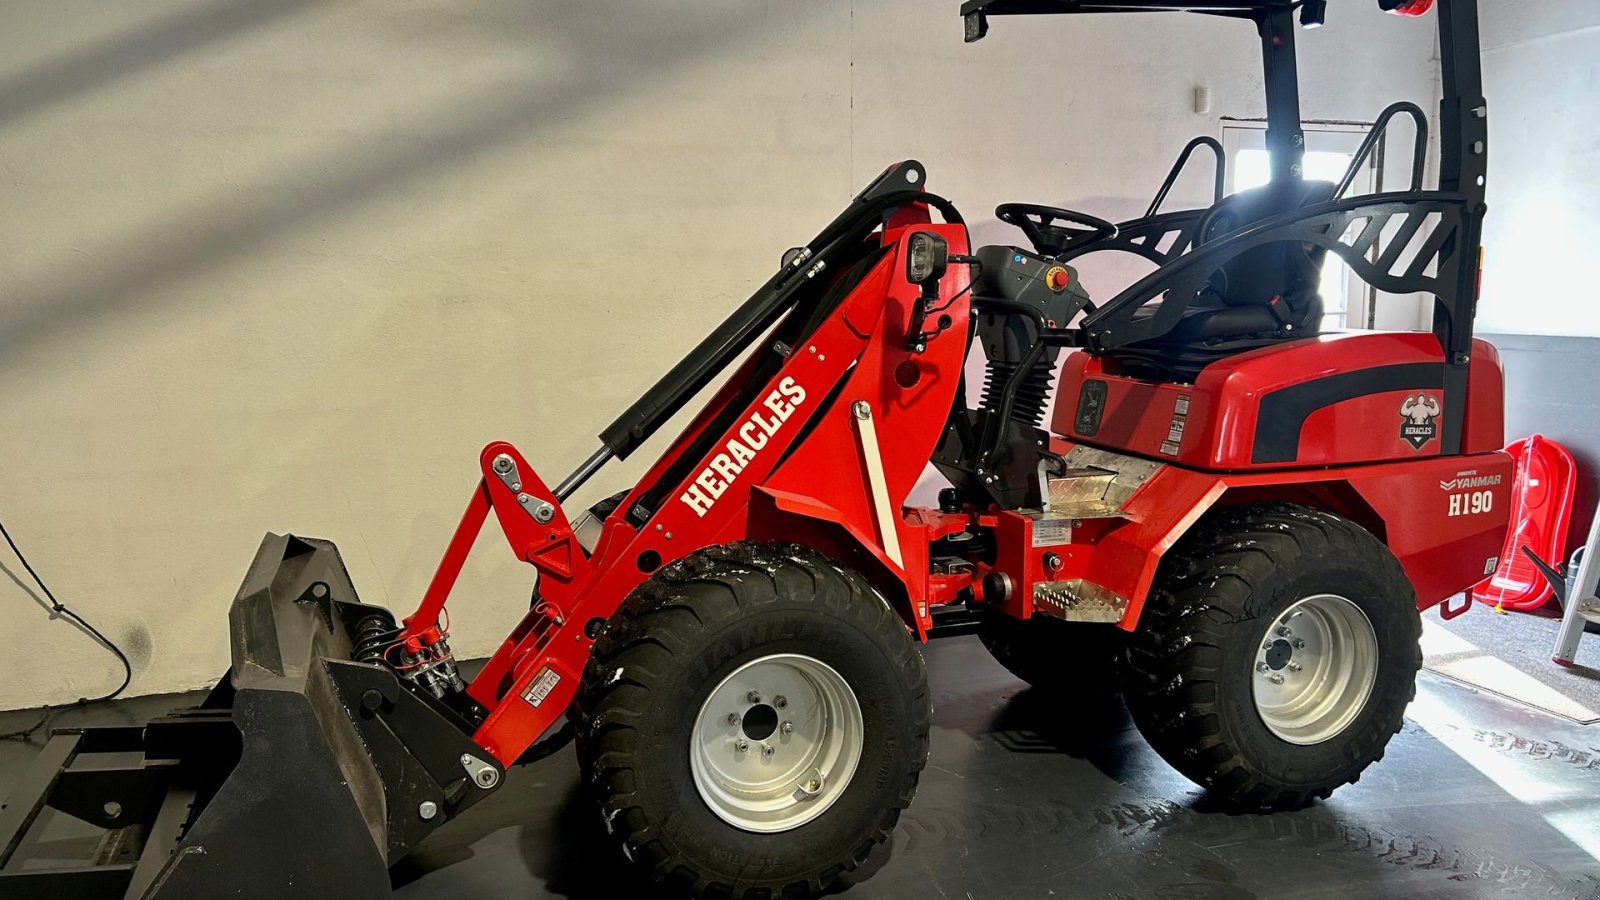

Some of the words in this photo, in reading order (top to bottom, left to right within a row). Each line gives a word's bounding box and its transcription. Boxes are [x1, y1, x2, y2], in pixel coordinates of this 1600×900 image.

[1405, 427, 1431, 435] HERACLES
[679, 376, 807, 518] HERACLES
[1456, 475, 1501, 488] YANMAR
[1448, 490, 1493, 517] H190
